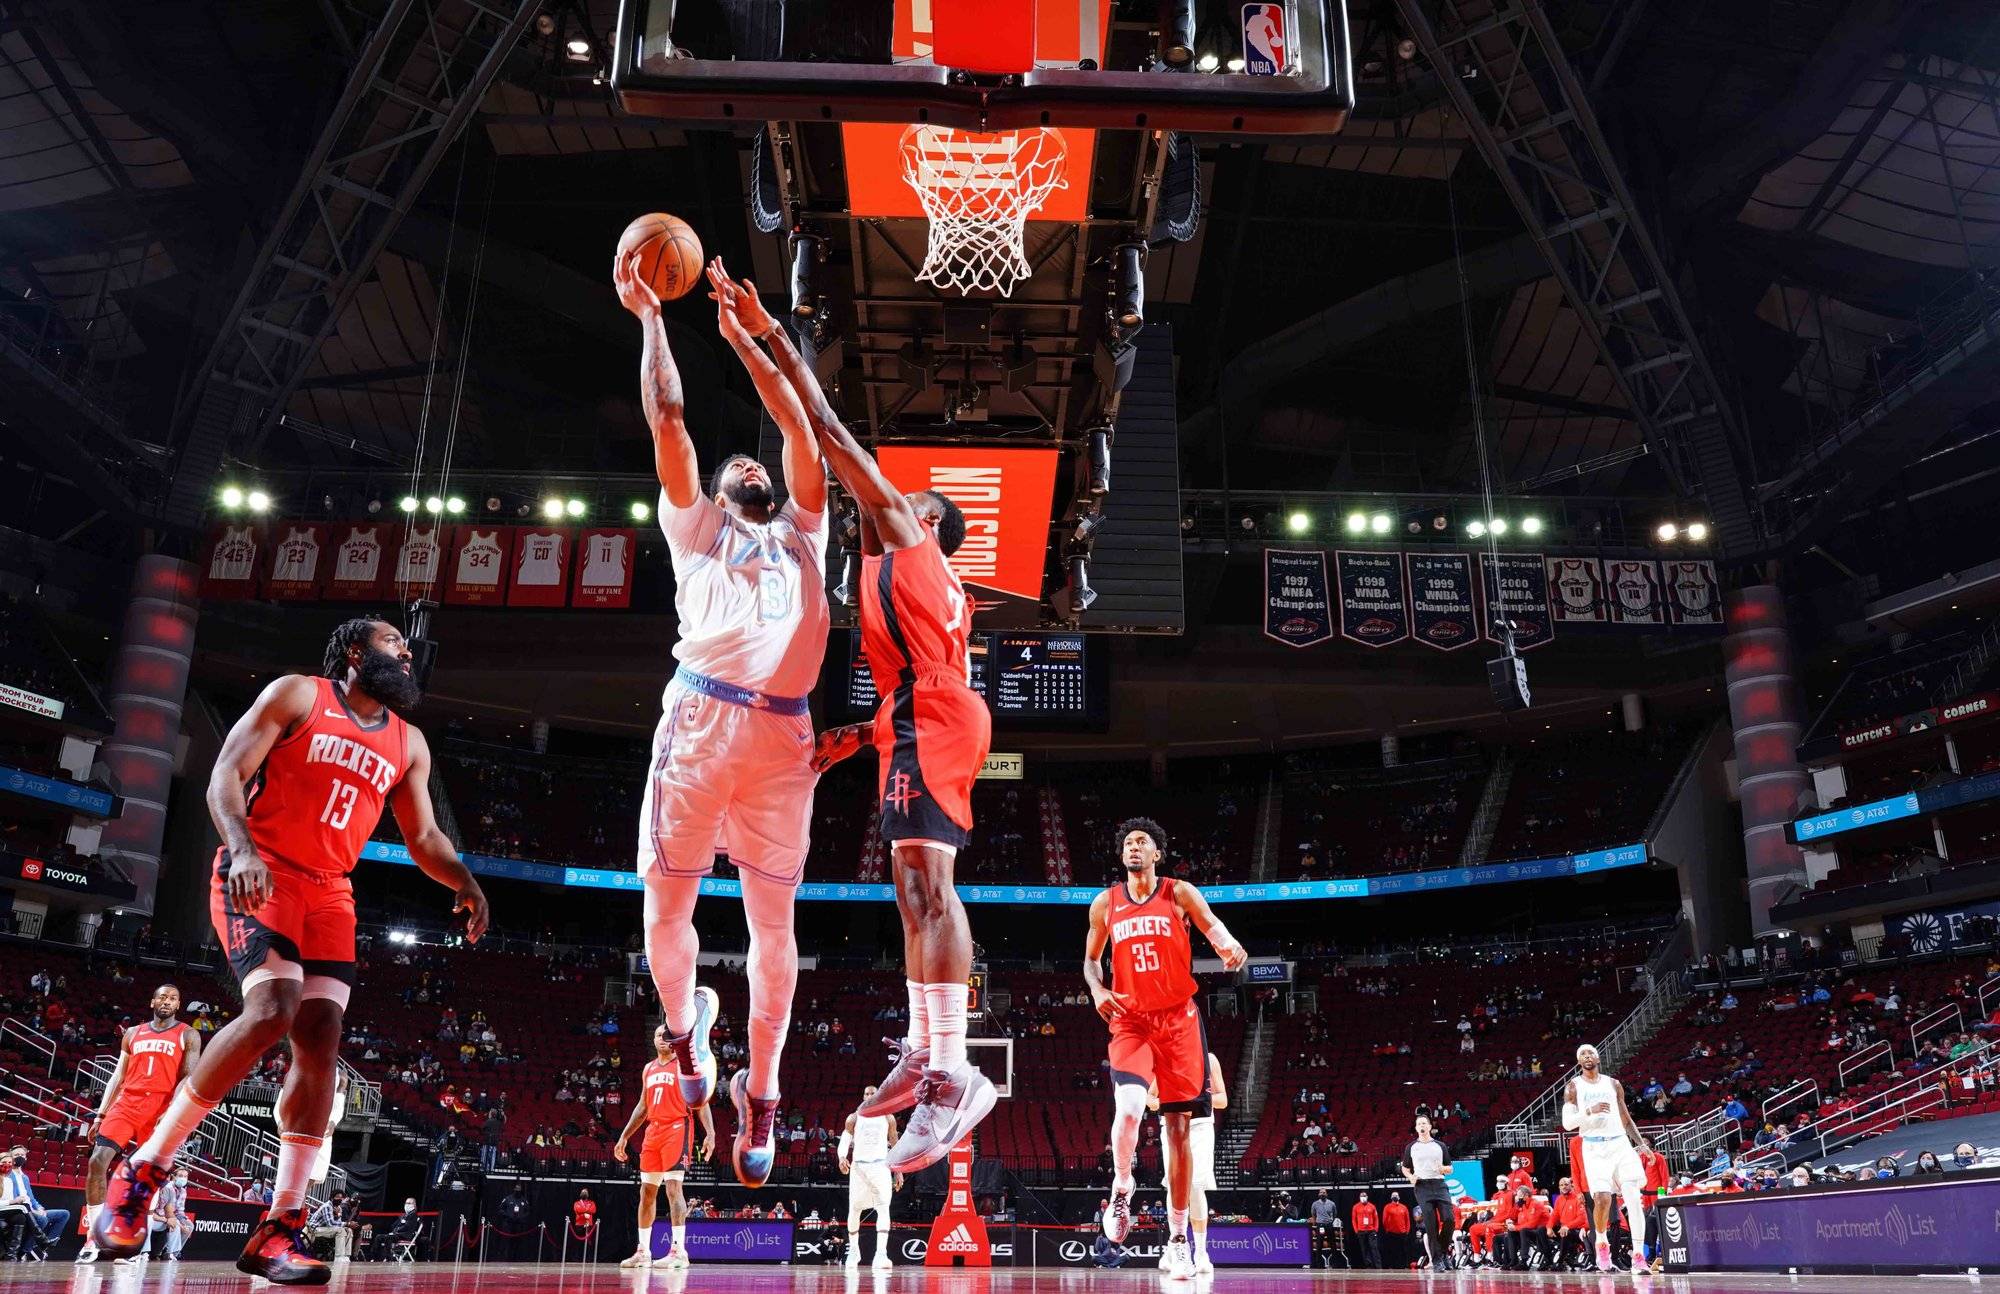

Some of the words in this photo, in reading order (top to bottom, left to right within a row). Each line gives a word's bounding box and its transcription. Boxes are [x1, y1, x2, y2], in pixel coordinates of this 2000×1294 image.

[1251, 61, 1271, 73] NBA
[344, 541, 378, 551] MALONE
[463, 544, 501, 555] OLAJUWON
[225, 549, 243, 562] 45
[288, 549, 306, 563] 23
[349, 550, 368, 563] 24
[410, 552, 428, 564] 22
[470, 554, 489, 567] 34
[602, 548, 611, 562] 11
[1348, 558, 1391, 566] Back-to-Back
[1426, 561, 1432, 569] 3
[1454, 561, 1462, 569] 10
[1285, 576, 1309, 586] 1997
[1357, 577, 1386, 587] 1998
[1428, 578, 1454, 589] 1999
[1501, 578, 1529, 588] 2000
[760, 569, 788, 619] 3
[1281, 587, 1314, 598] WNBA
[1354, 588, 1390, 598] WNBA
[1425, 590, 1459, 600] WNBA
[1500, 590, 1533, 600] WNBA
[1570, 587, 1583, 597] 10
[1628, 589, 1641, 599] 14
[1270, 597, 1326, 611] Champions
[1345, 599, 1402, 611] Champions
[1415, 601, 1471, 613] Champions
[1489, 601, 1546, 613] Champions
[1020, 646, 1032, 661] 4
[23, 694, 45, 705] YOUR
[0, 695, 37, 711] ROCKETS
[38, 707, 57, 717] APP!
[1943, 699, 1987, 719] CORNER
[1845, 725, 1892, 746] CLUTCH'S
[305, 733, 397, 795] ROCKETS
[25, 781, 51, 793] AT&T
[81, 795, 106, 809] AT&T
[319, 777, 359, 830] 13
[1866, 805, 1890, 818] AT&T
[1815, 817, 1839, 831] AT&T
[1618, 850, 1640, 861] AT&T
[1475, 870, 1497, 880] AT&T
[1521, 865, 1543, 874] AT&T
[45, 868, 88, 885] TOYOTA
[579, 873, 600, 883] AT&T
[626, 877, 645, 886] AT&T
[1428, 875, 1449, 884] AT&T
[716, 883, 737, 892] AT&T
[1338, 884, 1360, 893] AT&T
[1382, 880, 1402, 888] AT&T
[807, 887, 827, 895] AT&T
[849, 888, 870, 896] AT&T
[1027, 891, 1047, 899] AT&T
[1072, 891, 1092, 899] AT&T
[1204, 890, 1225, 899] AT&T
[1246, 888, 1266, 896] AT&T
[1292, 886, 1312, 895] AT&T
[1112, 916, 1172, 944] ROCKETS
[1131, 941, 1160, 973] 35
[1252, 965, 1281, 975] BBVA
[133, 1039, 176, 1057] ROCKETS
[147, 1056, 154, 1076] 1
[230, 1103, 272, 1118] TUNNEL
[195, 1220, 220, 1233] TOYOTA
[220, 1221, 249, 1234] CENTER
[1692, 1226, 1742, 1244] Apartment
[1759, 1222, 1781, 1241] List
[1816, 1218, 1883, 1242] Apartment
[1908, 1213, 1938, 1236] List
[660, 1232, 731, 1246] Artment
[757, 1233, 781, 1245] List
[1275, 1237, 1299, 1249] List
[938, 1241, 978, 1252] adidas
[1089, 1245, 1168, 1258] LXUS
[1668, 1247, 1687, 1264] AT&T
